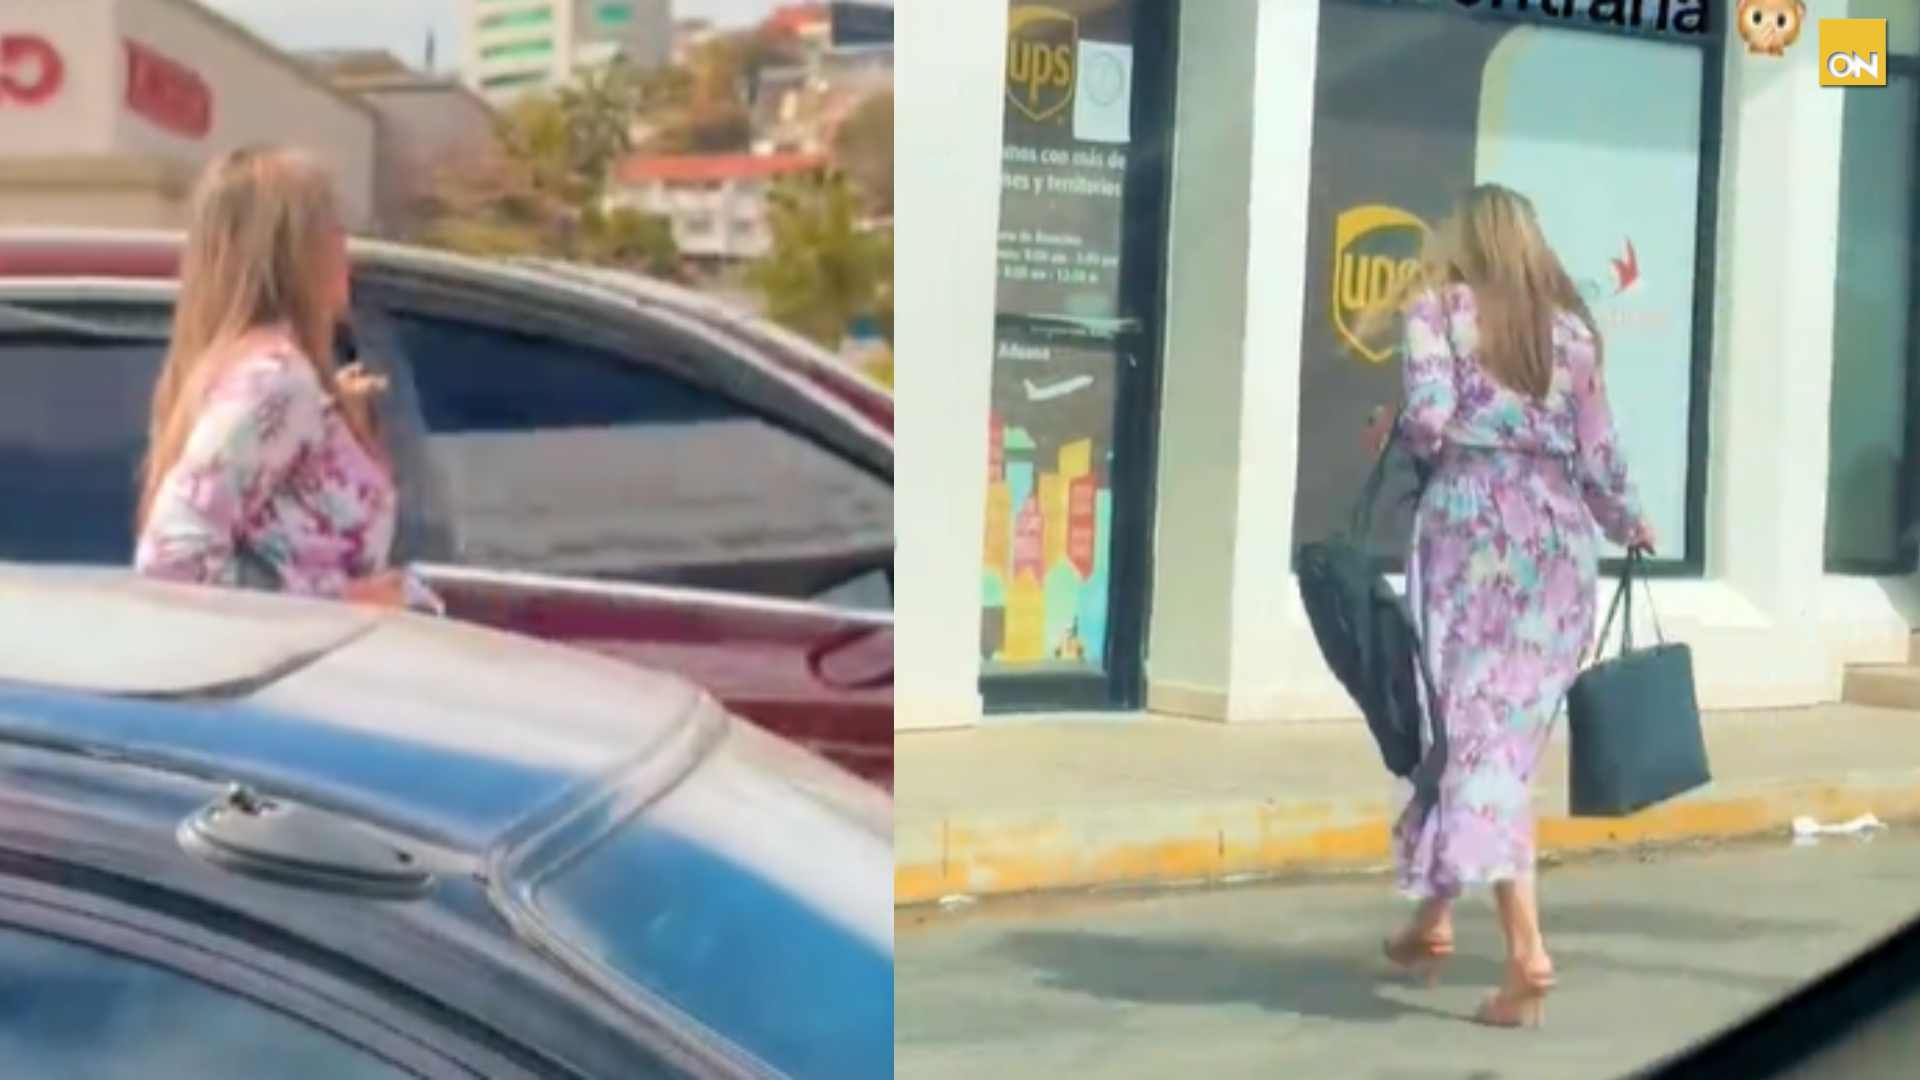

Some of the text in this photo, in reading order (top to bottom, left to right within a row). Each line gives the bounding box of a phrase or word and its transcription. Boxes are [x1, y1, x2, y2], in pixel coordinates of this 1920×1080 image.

[1009, 38, 1071, 107] ups
[1040, 148, 1070, 166] con
[1107, 148, 1126, 171] de
[1032, 177, 1042, 197] y
